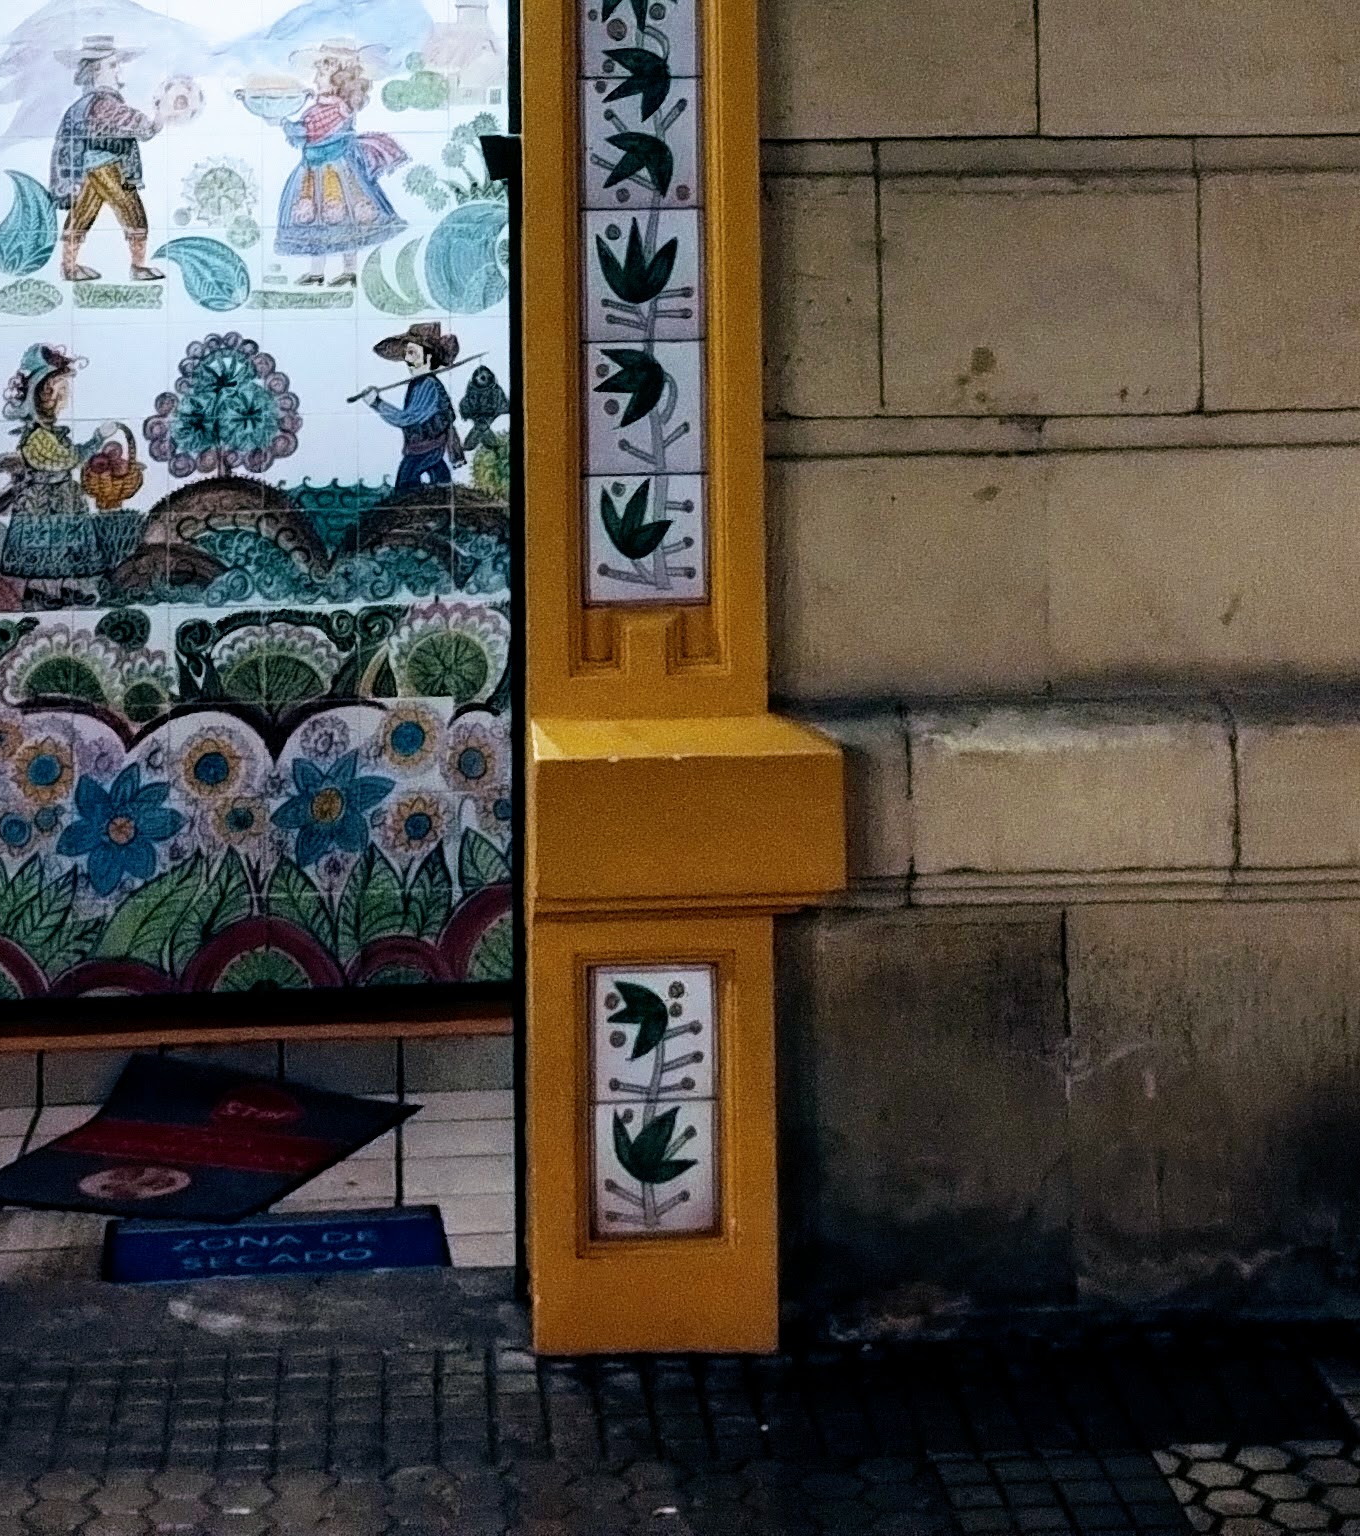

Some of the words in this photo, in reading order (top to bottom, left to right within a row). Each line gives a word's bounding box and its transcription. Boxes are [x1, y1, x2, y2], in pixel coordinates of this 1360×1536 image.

[171, 1232, 304, 1252] ZONA
[320, 1229, 381, 1246] DE
[181, 1247, 374, 1271] SECADO
